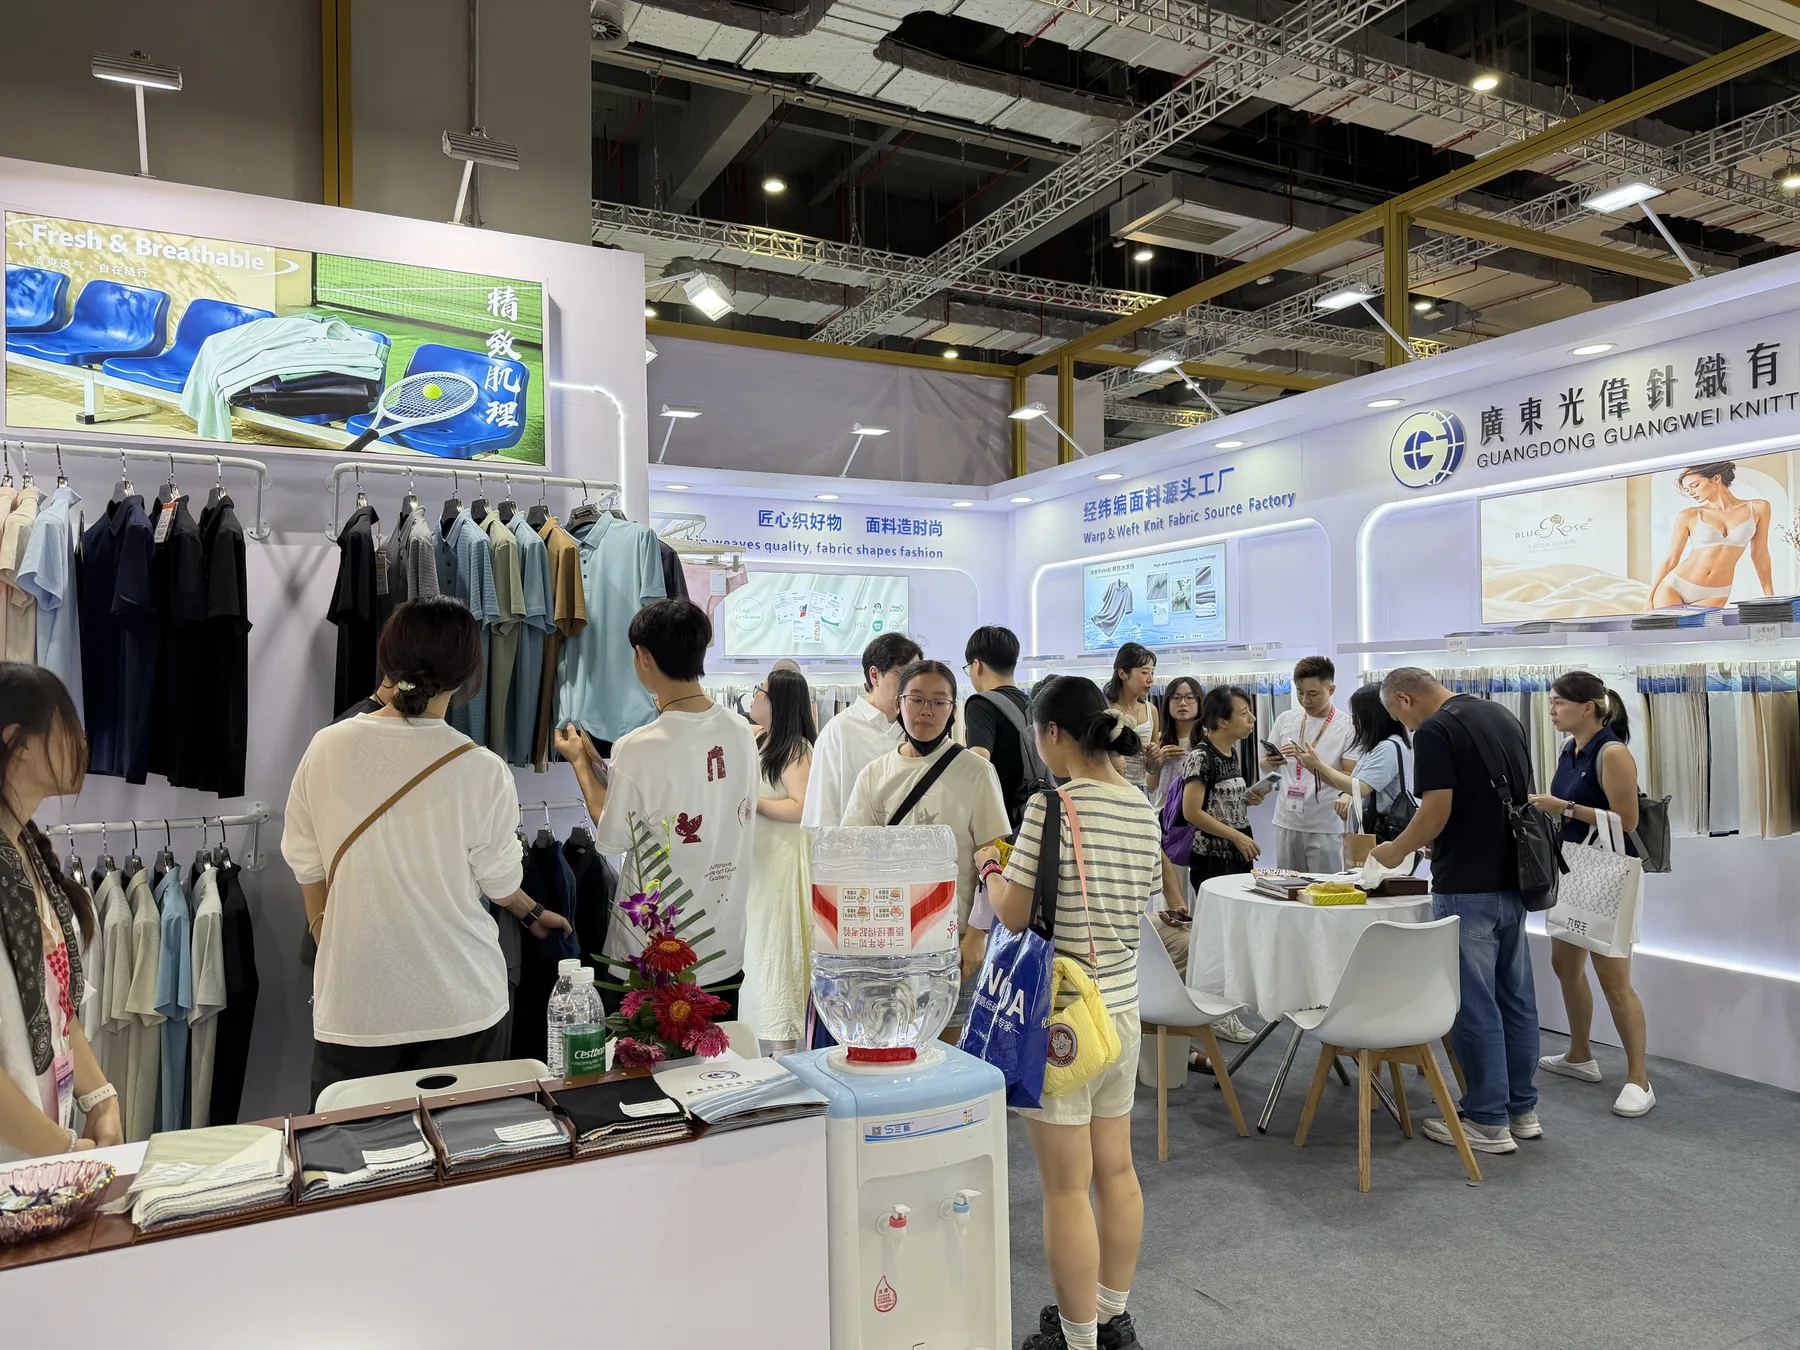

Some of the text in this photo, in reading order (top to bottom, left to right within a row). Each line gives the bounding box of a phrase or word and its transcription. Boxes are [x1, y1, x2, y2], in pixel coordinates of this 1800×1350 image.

[32, 223, 265, 271] Fresh & Breathable
[484, 285, 522, 429] 精致肌理
[1476, 432, 1596, 469] GUANGDONG
[1604, 407, 1721, 446] GUANGWEI
[1083, 466, 1236, 523] 经纬编面料源头工厂
[1083, 491, 1296, 544] Warp & Weft Knit Fabric Source Factory
[758, 509, 943, 537] 匠心织好物 面料造时尚
[764, 539, 812, 555] quality,
[816, 541, 852, 555] fabric
[856, 543, 897, 558] shapes
[900, 545, 943, 559] fashion
[843, 938, 905, 949] 二十余年如一日
